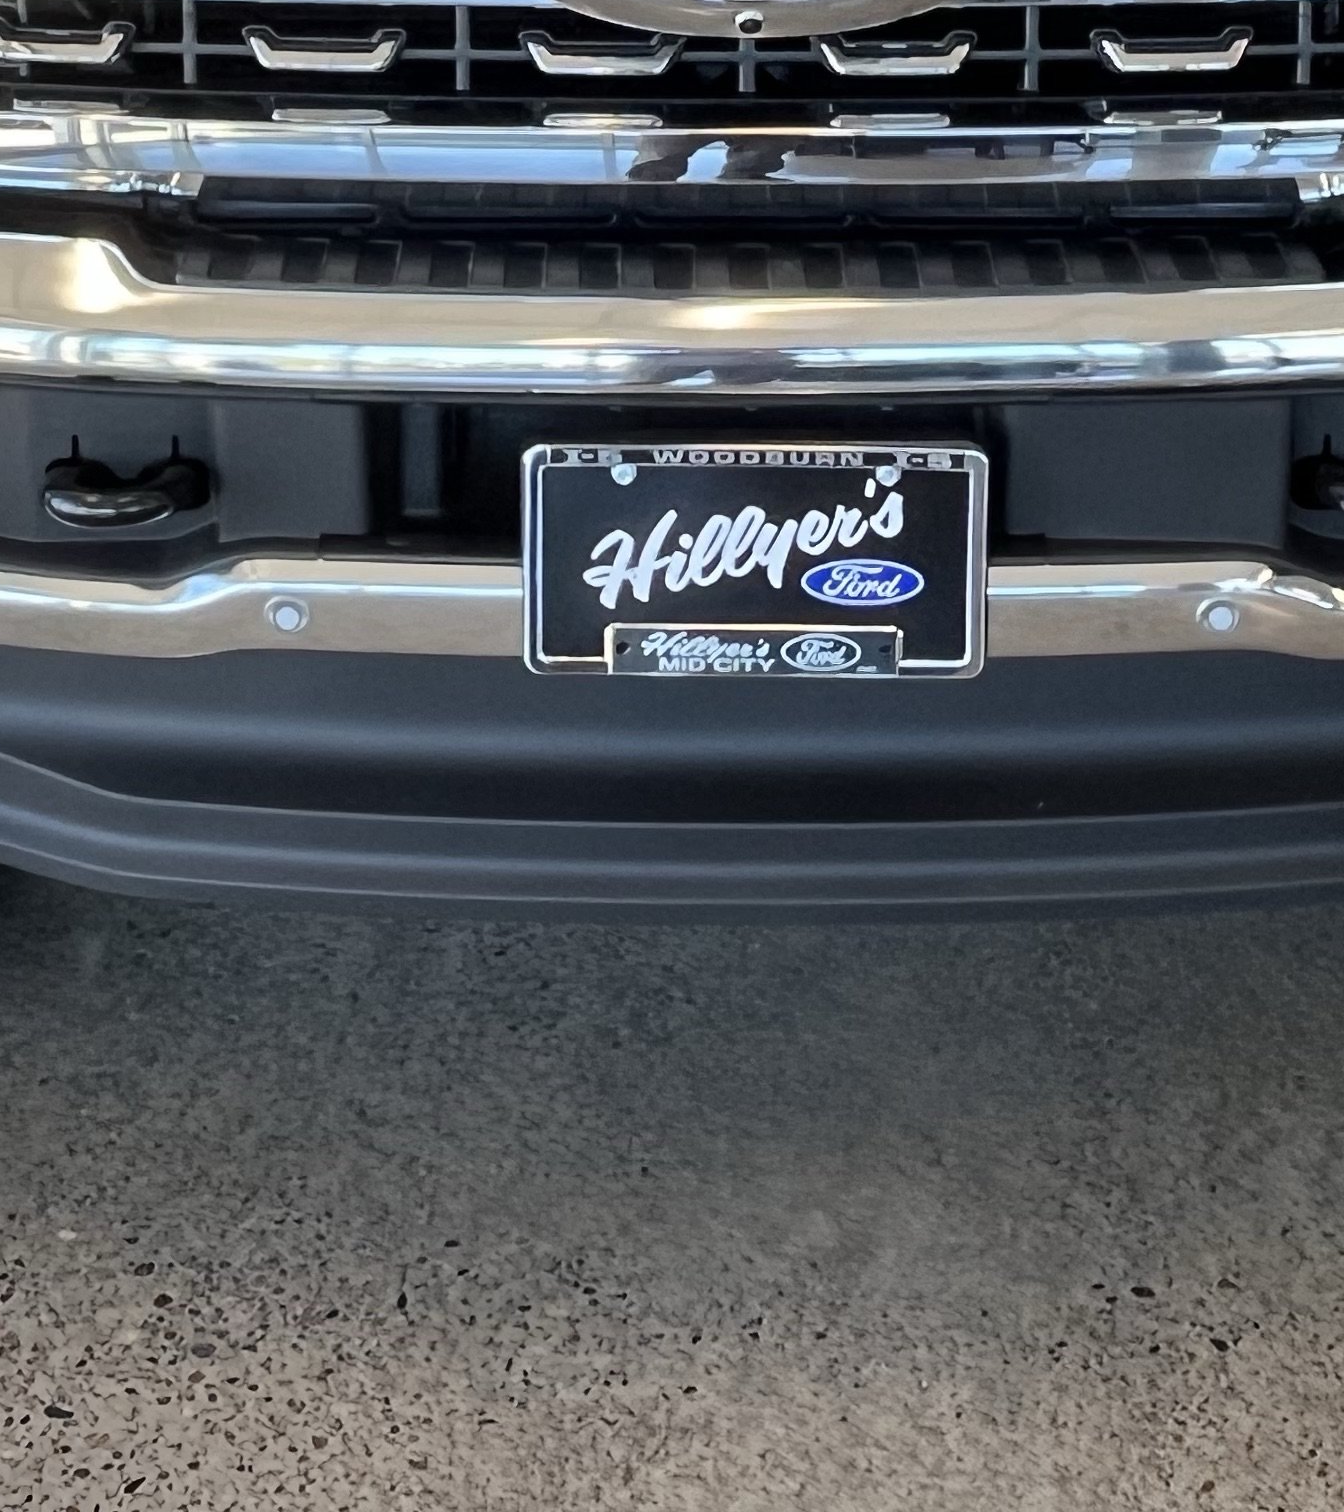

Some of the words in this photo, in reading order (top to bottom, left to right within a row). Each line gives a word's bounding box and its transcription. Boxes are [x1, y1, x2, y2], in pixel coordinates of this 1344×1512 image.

[653, 449, 864, 467] WOODBURN
[582, 477, 904, 609] Hillyer's
[821, 564, 904, 599] Ford
[658, 657, 706, 673] MID
[713, 657, 775, 673] CITY
[796, 639, 846, 666] Ford
